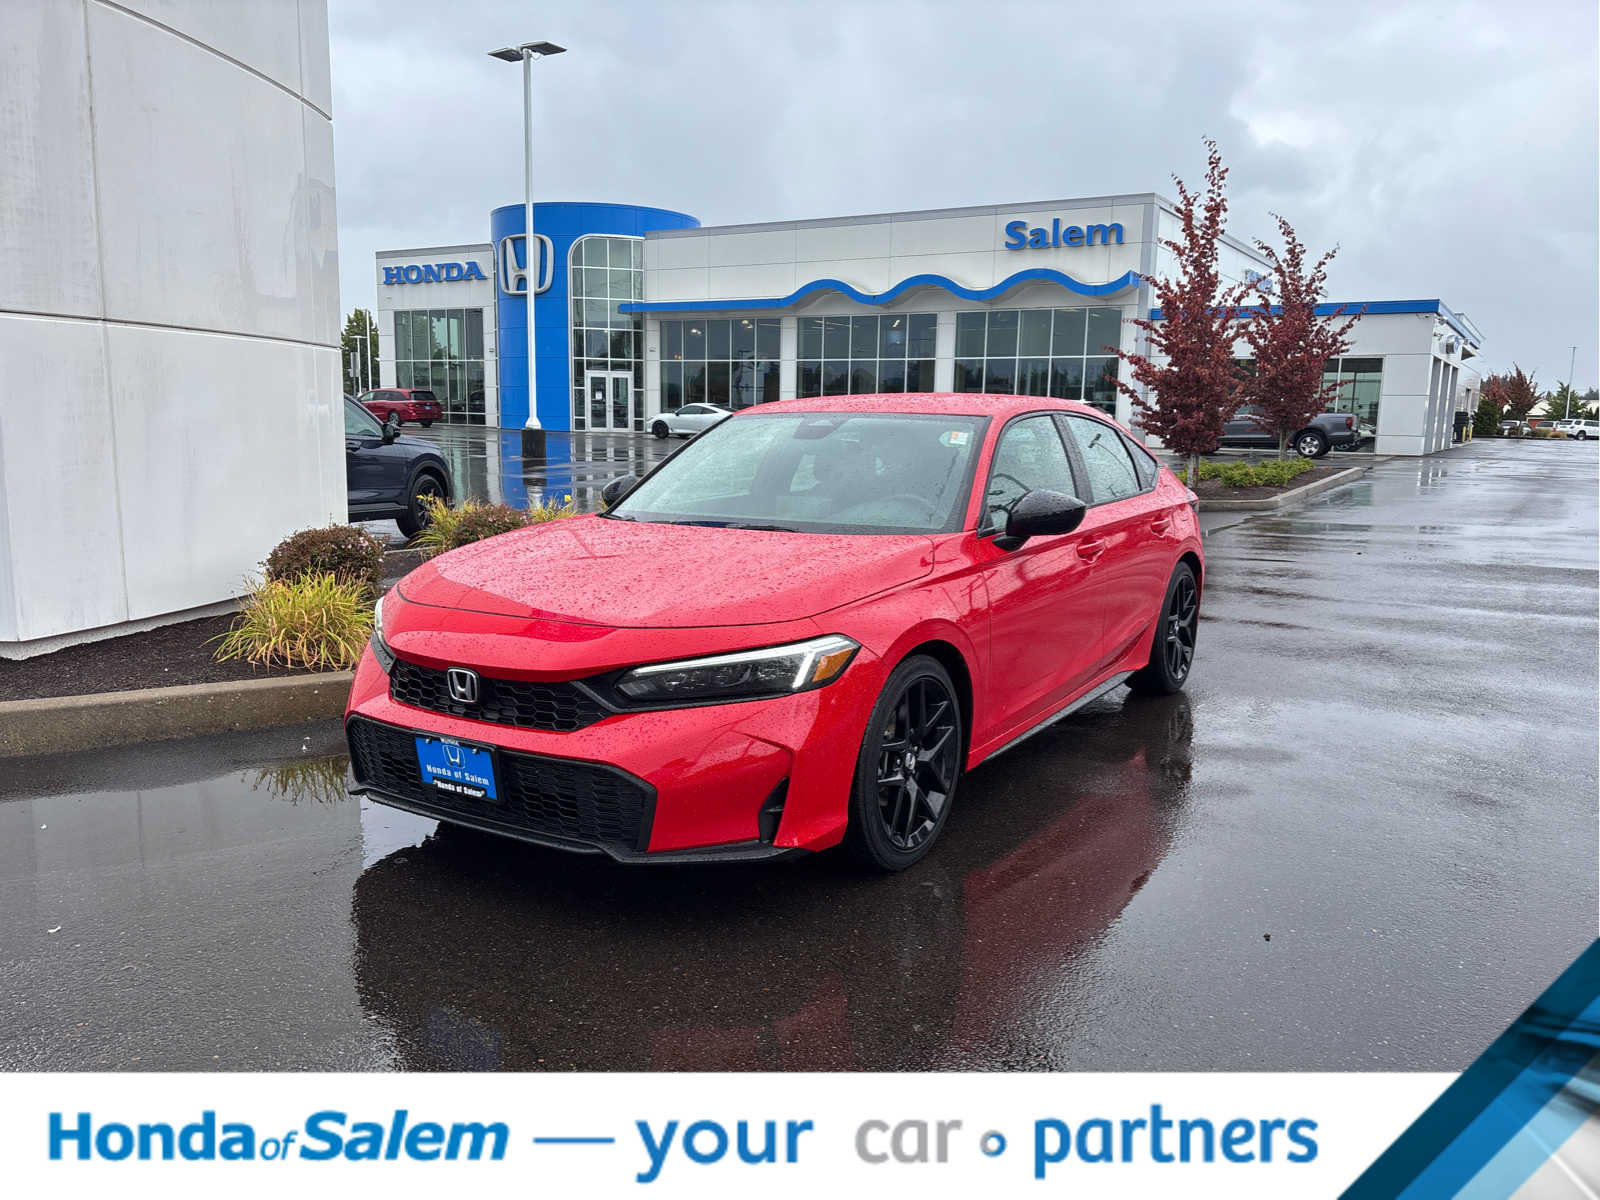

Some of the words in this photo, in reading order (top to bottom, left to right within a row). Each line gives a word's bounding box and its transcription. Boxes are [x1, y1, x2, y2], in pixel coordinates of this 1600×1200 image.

[1005, 217, 1124, 250] Salem
[383, 261, 488, 285] HONDA
[426, 764, 452, 777] Honda
[464, 772, 490, 786] Salem
